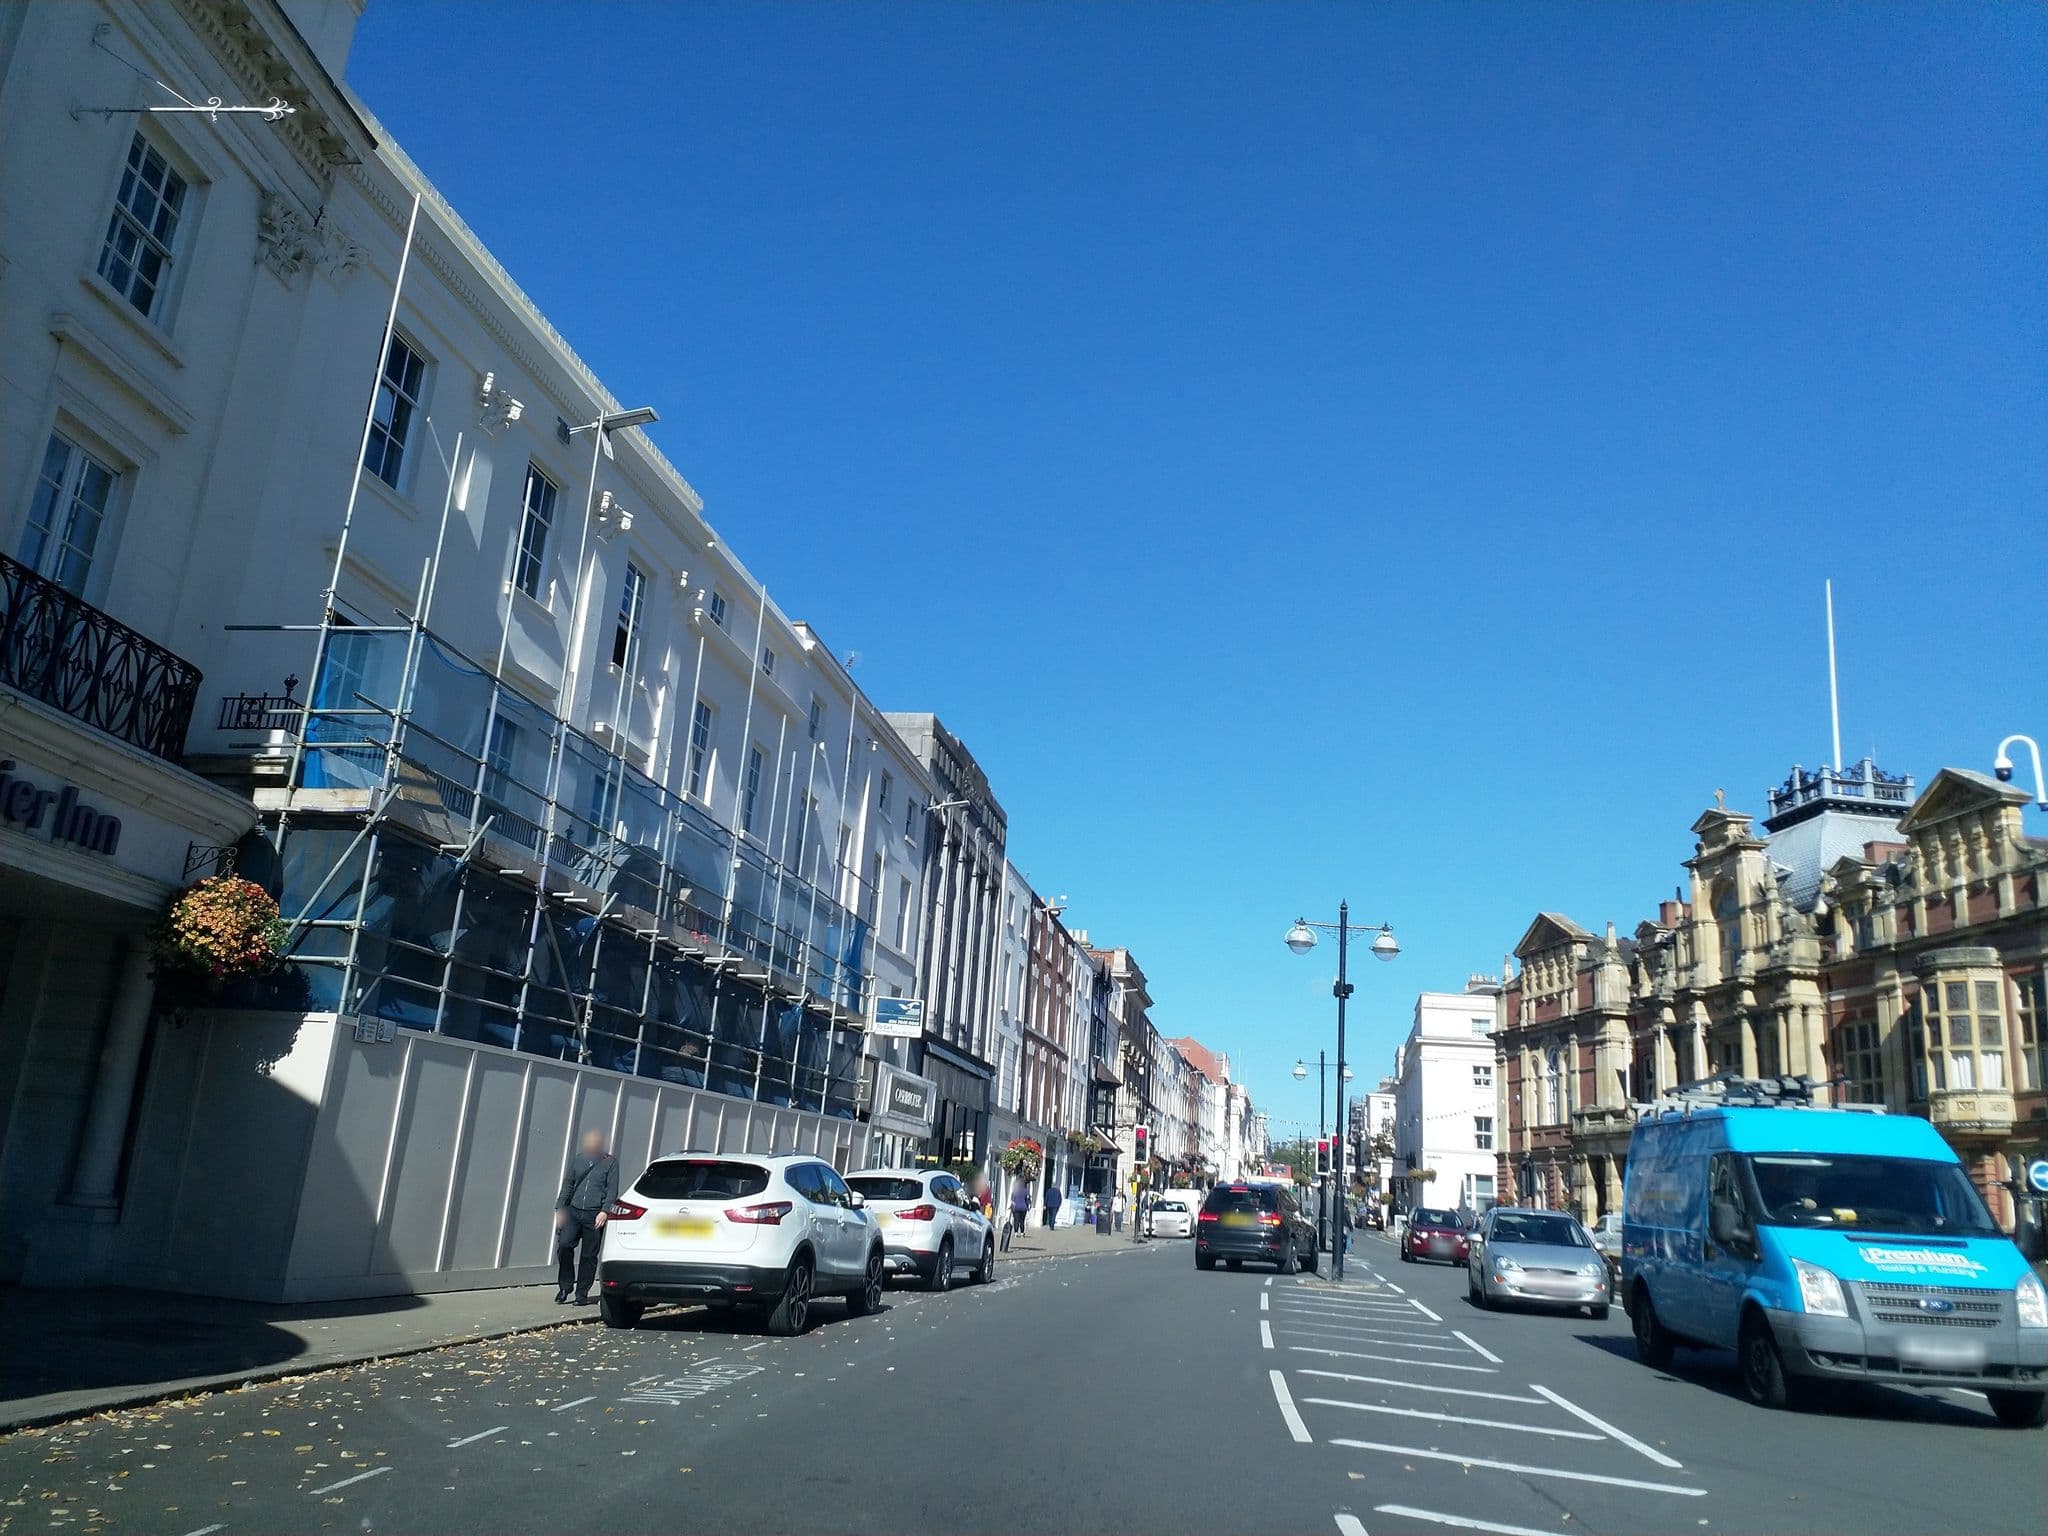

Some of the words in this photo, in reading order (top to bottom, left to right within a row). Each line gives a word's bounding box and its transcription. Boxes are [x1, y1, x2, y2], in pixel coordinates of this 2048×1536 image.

[54, 786, 122, 855] Inn
[1867, 1248, 1969, 1266] Premium
[616, 1364, 766, 1406] DISABLED
